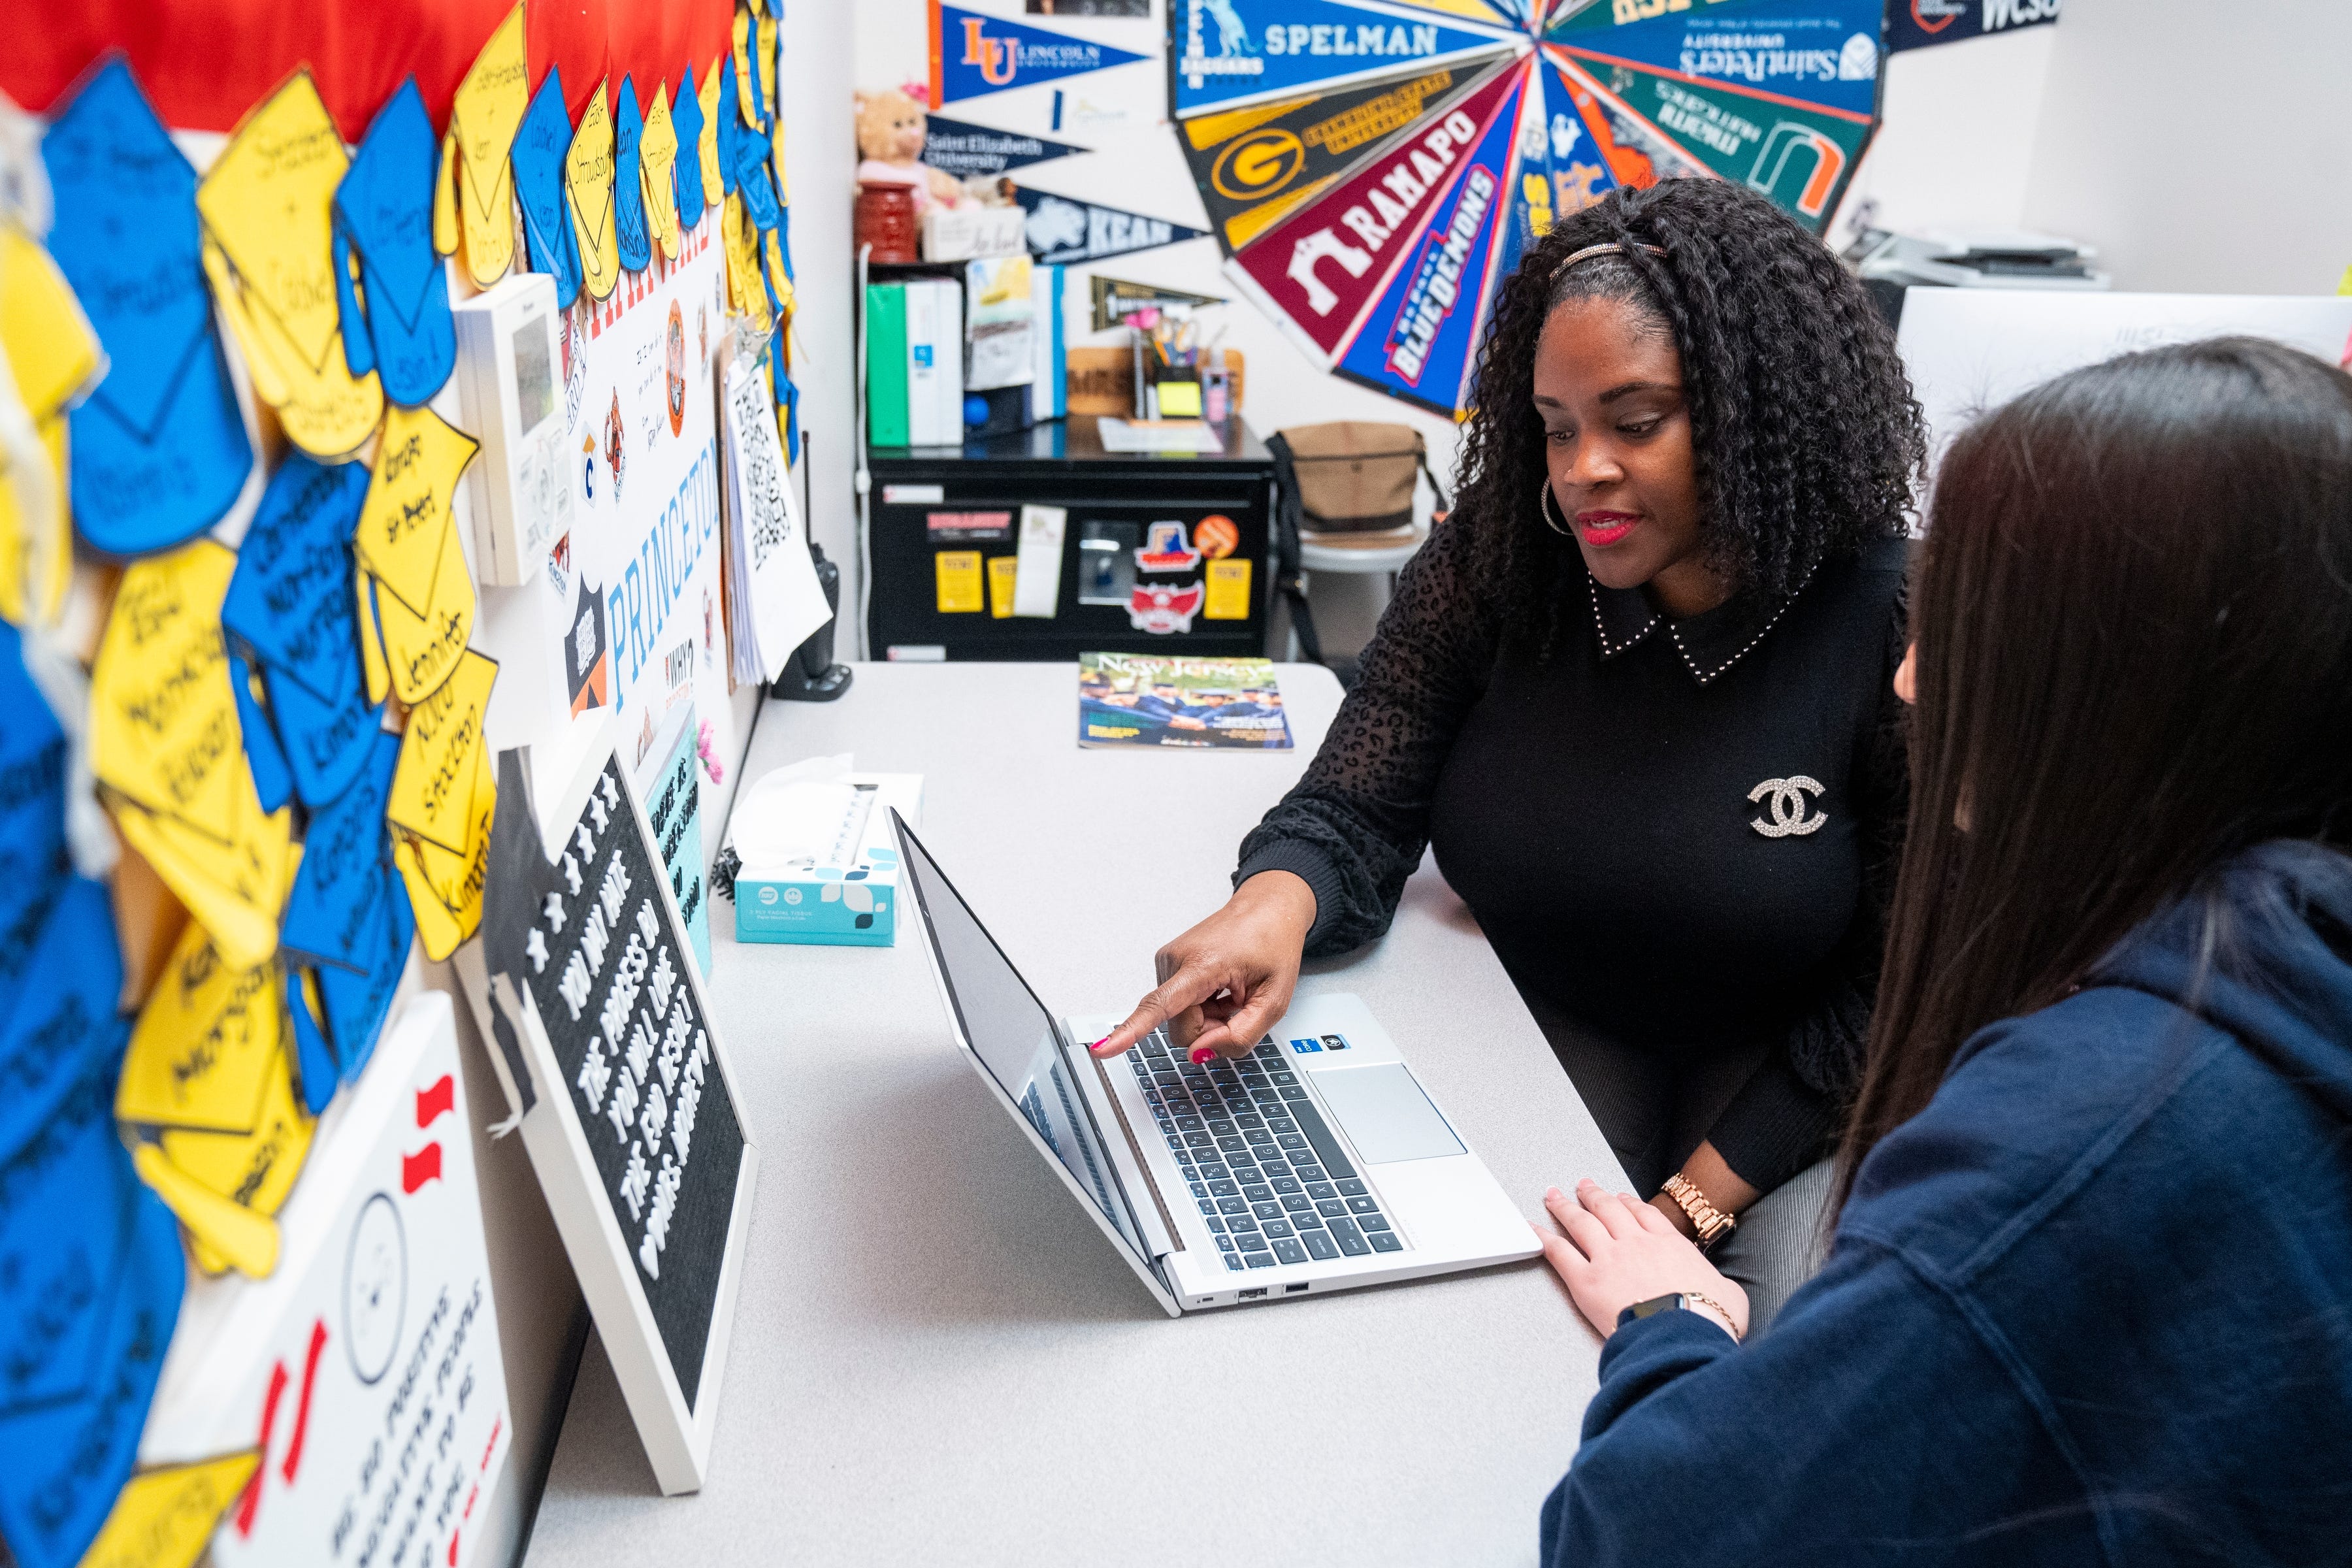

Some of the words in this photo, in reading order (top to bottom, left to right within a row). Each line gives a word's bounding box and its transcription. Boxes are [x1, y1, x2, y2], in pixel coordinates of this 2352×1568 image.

[1017, 44, 1101, 60] LINCOLN
[1265, 24, 1438, 56] SPELMAN
[1682, 33, 1785, 49] UNIVERSITY
[925, 132, 966, 152] Saint
[968, 135, 1043, 155] Elizabeth
[1342, 109, 1477, 252] RAMAPO
[1087, 208, 1173, 257] KEAN
[1392, 295, 1443, 380] BLUE
[1428, 169, 1496, 310] DEMONS
[1098, 654, 1164, 677] New
[1169, 659, 1260, 681] Jersey
[558, 950, 592, 1022] YOU
[580, 904, 610, 978] MAY
[598, 849, 632, 928] HATE
[578, 1036, 612, 1115] THE
[600, 933, 648, 1056] PROCESS
[608, 1066, 640, 1145] YOU
[625, 1008, 659, 1086] WILL
[647, 945, 678, 1021] LOVE
[620, 1141, 652, 1224] THE
[640, 1083, 668, 1157] END
[657, 985, 694, 1097] RESULT
